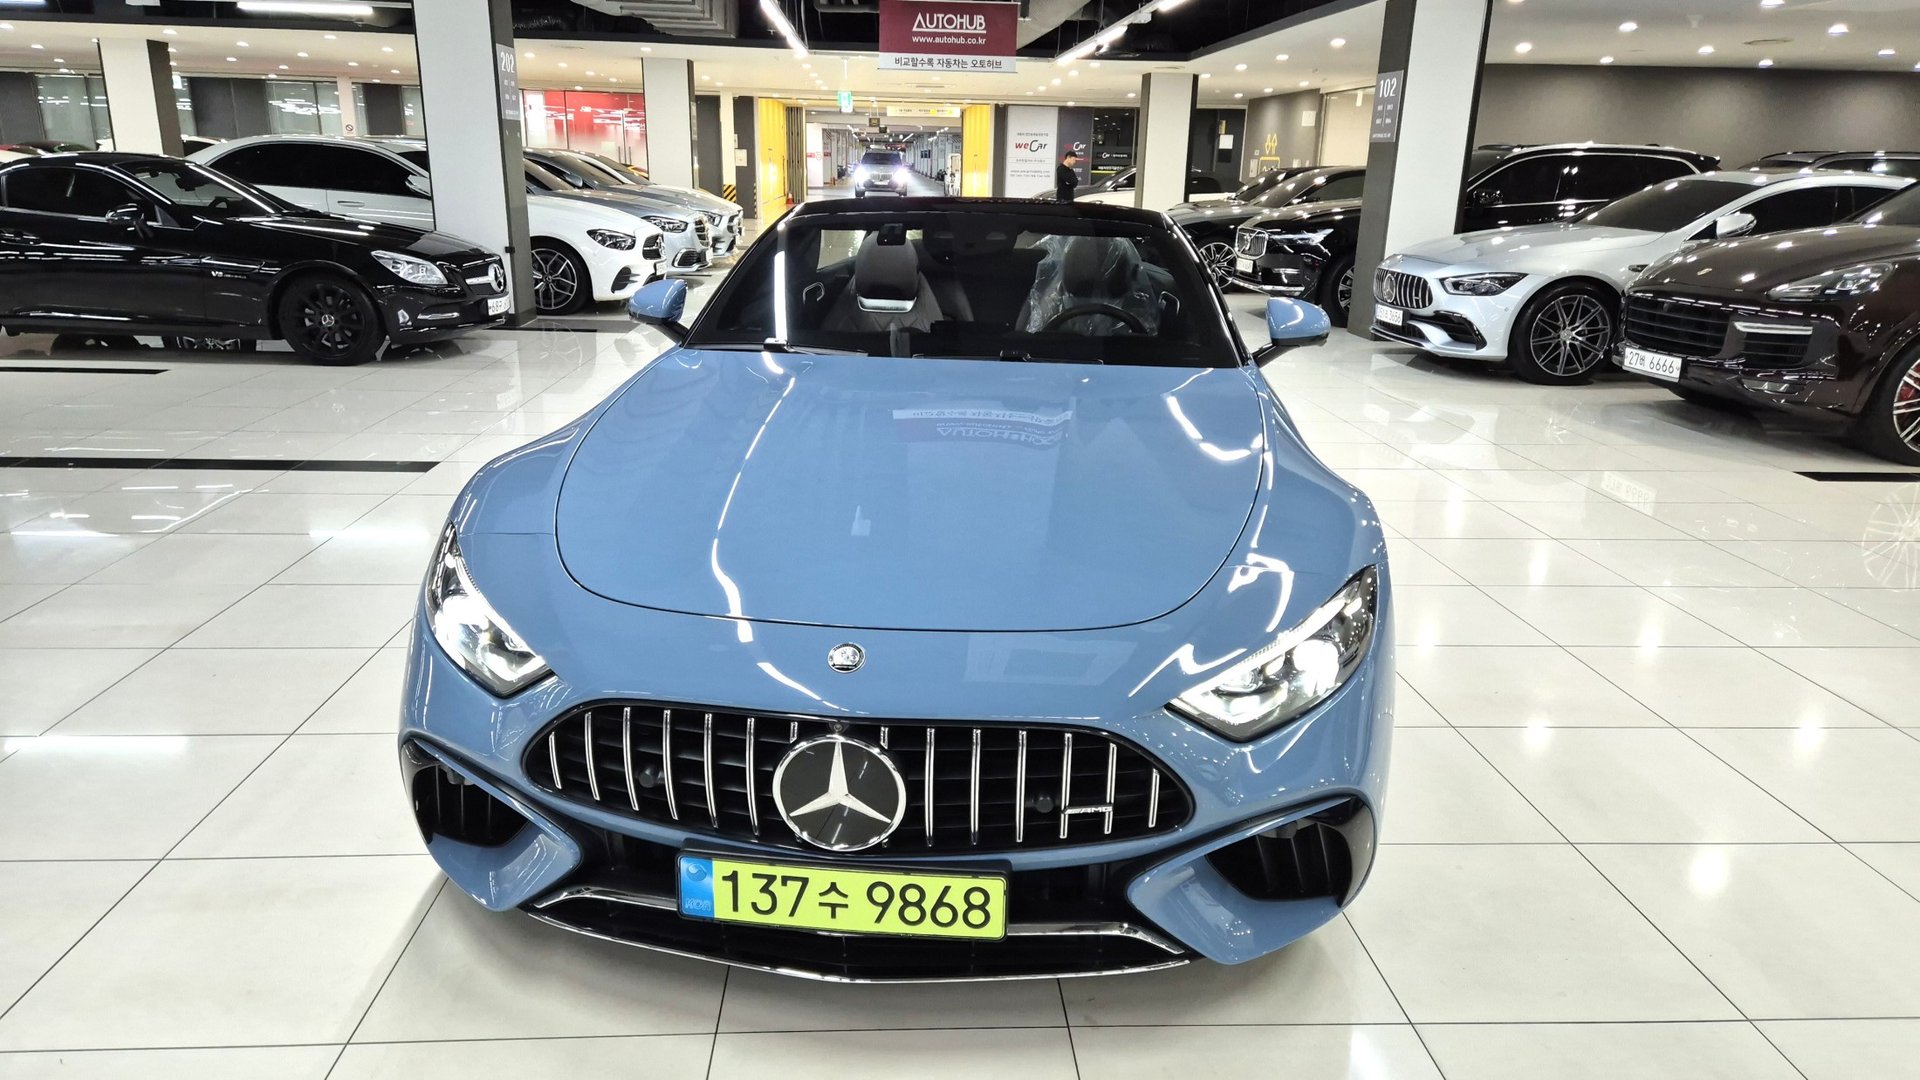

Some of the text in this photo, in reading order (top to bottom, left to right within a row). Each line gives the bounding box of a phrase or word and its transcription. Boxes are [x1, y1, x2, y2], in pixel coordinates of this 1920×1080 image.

[912, 12, 987, 33] AUTOHUB
[912, 35, 987, 45] www.autohub.co.kr
[500, 51, 516, 73] 202
[894, 56, 1003, 70] 비교할수록 자동차는 오토허브
[1379, 77, 1397, 98] 102
[1015, 139, 1048, 153] weCar
[1648, 356, 1675, 374] 6666
[721, 869, 991, 930] 137수 9868
